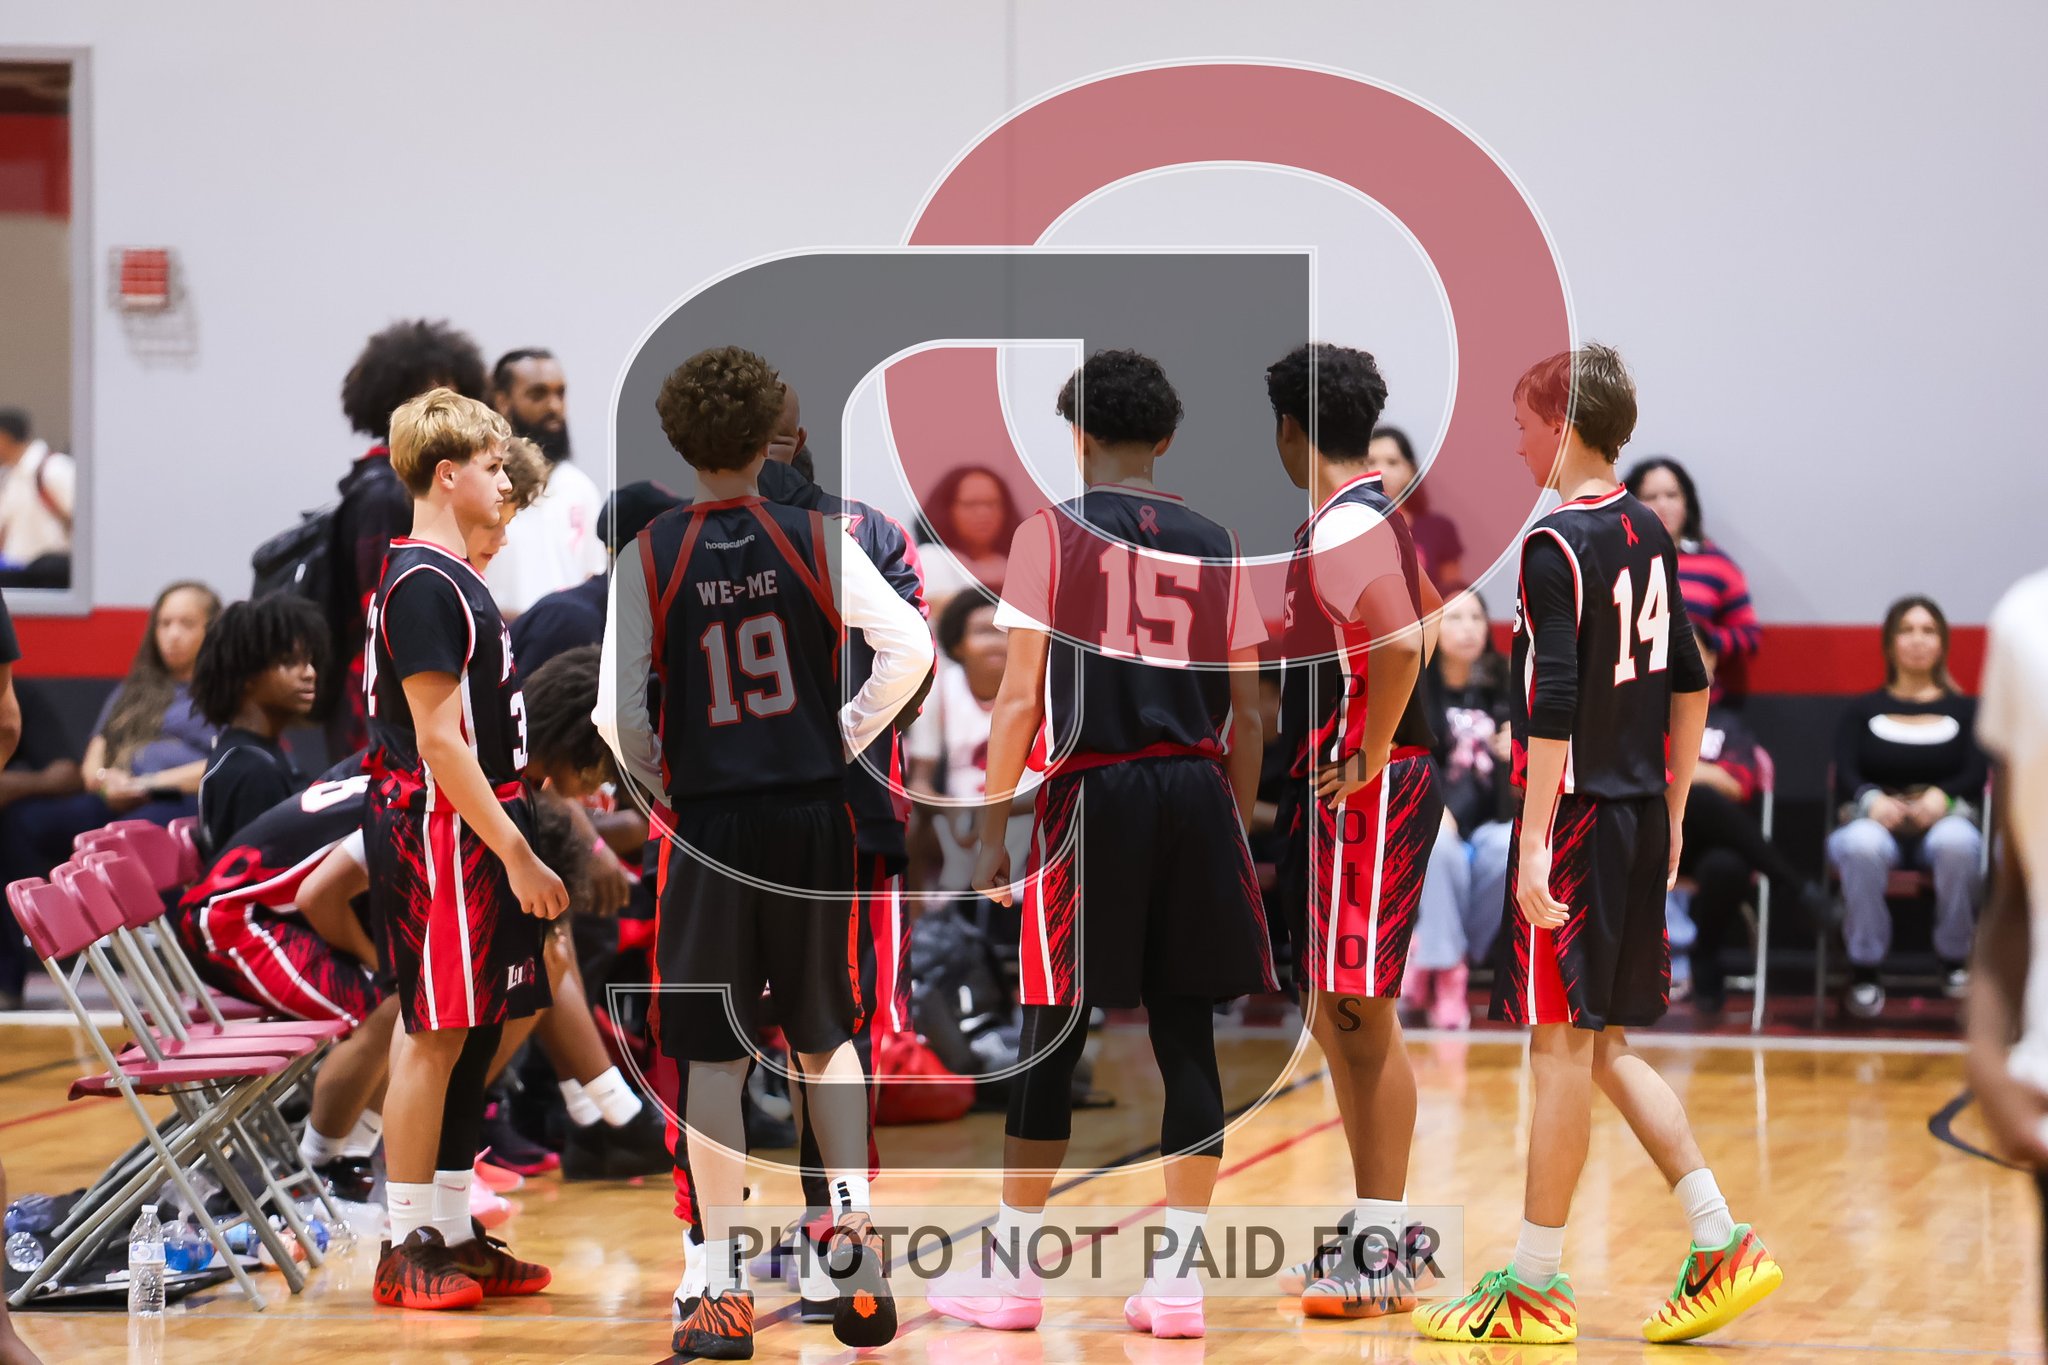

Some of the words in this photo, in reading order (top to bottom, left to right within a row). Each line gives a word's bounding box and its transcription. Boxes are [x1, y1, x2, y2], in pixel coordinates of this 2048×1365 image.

[705, 533, 756, 551] hoopculture
[1099, 541, 1201, 669] 15
[1612, 554, 1670, 688] 14
[700, 611, 797, 727] 19
